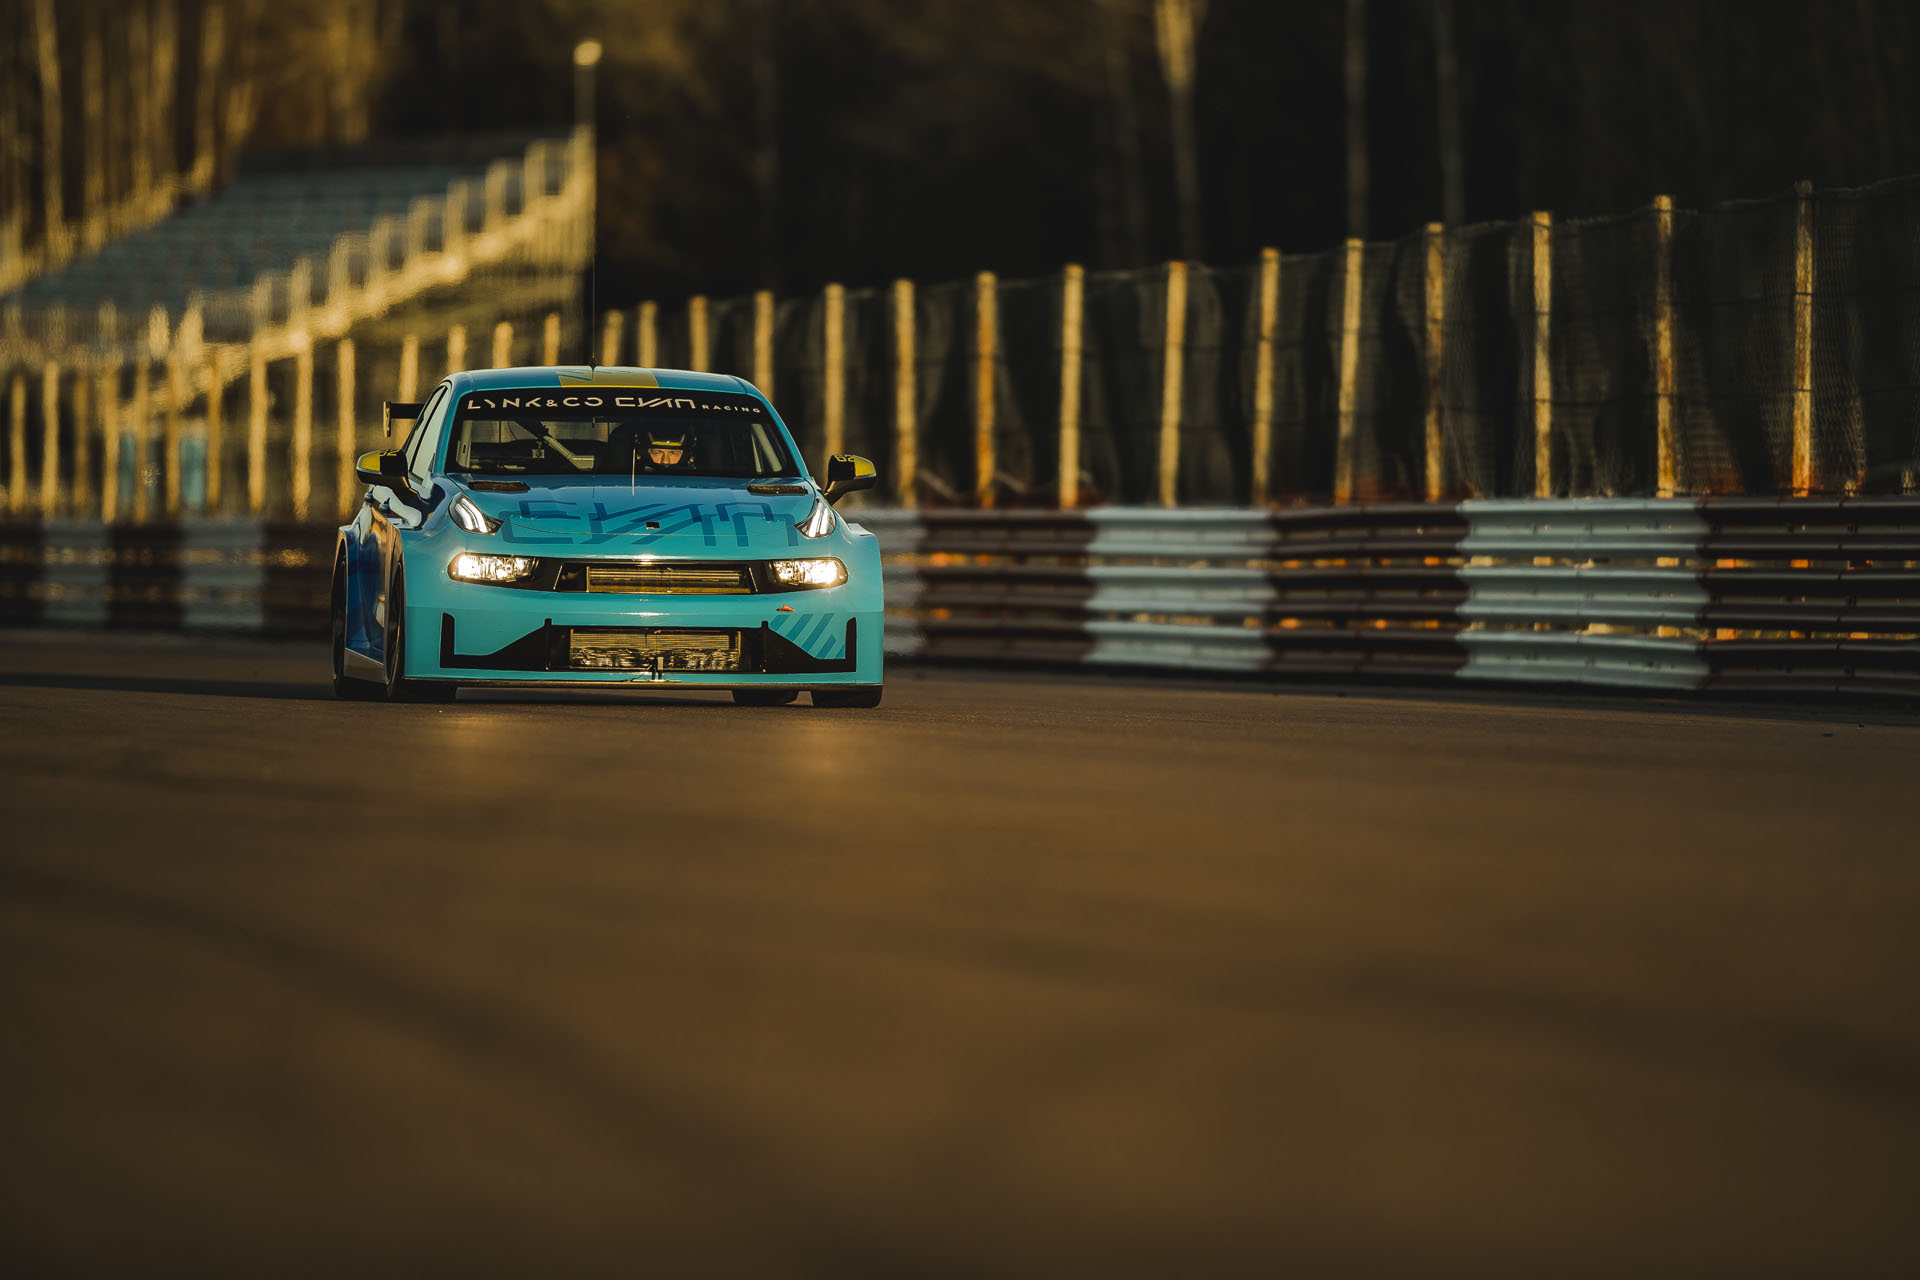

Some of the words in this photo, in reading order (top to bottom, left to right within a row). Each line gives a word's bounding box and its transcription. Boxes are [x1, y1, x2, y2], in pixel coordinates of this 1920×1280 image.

[467, 397, 603, 410] LYNK&CO
[615, 397, 696, 409] CYAN
[702, 404, 761, 413] RACING
[499, 500, 800, 548] CYAN
